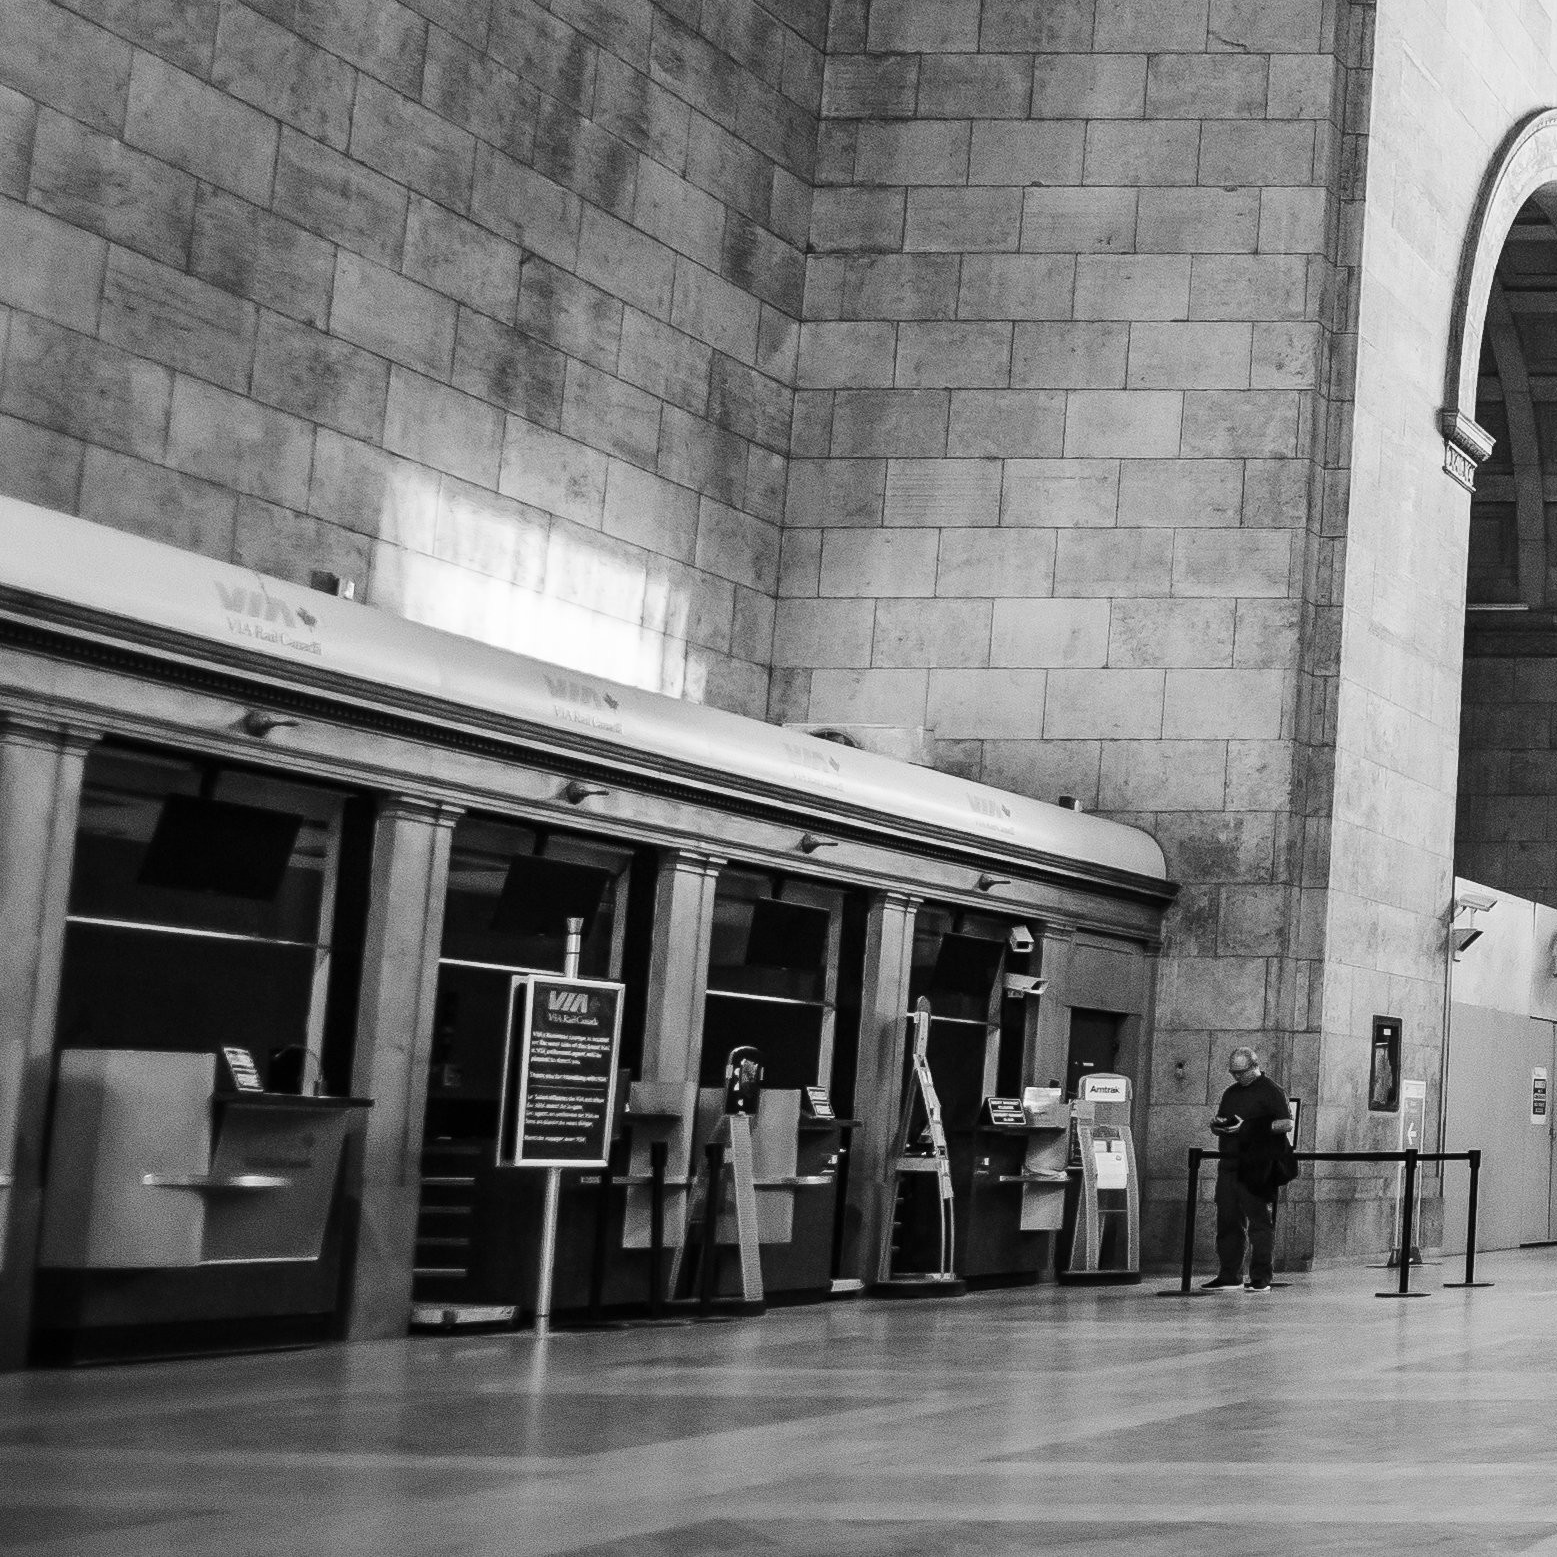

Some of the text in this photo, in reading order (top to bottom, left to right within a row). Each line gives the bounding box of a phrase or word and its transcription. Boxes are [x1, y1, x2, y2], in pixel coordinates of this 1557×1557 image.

[215, 580, 296, 629] VIA
[543, 673, 602, 711] VIA
[548, 990, 588, 1014] VIA
[1090, 1085, 1120, 1094] Amtrak
